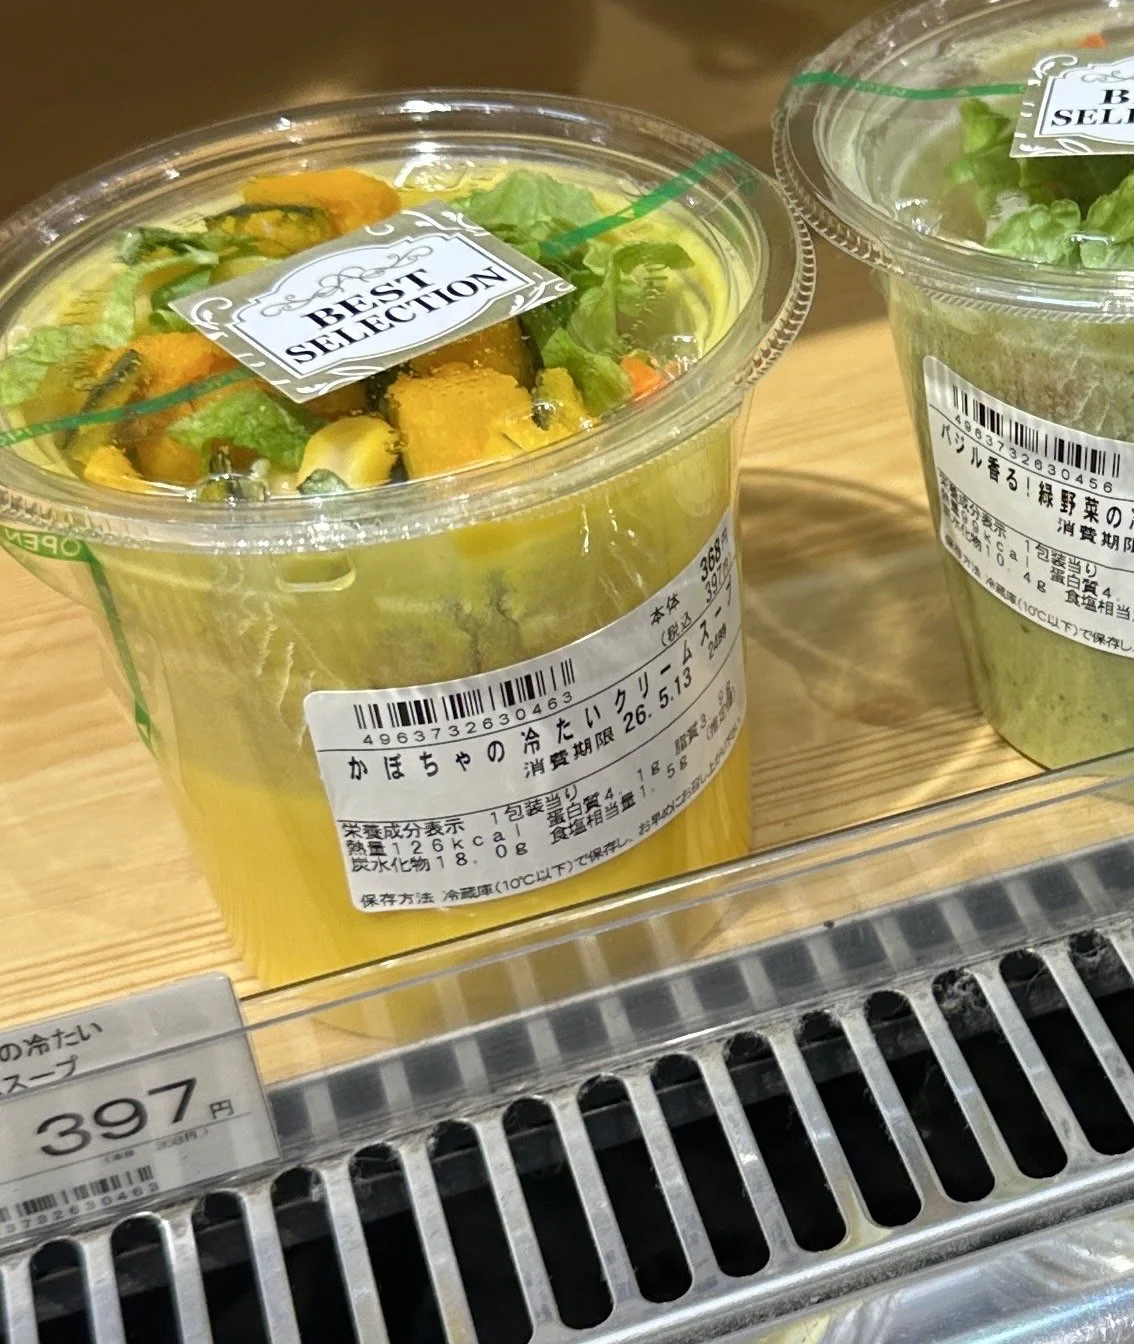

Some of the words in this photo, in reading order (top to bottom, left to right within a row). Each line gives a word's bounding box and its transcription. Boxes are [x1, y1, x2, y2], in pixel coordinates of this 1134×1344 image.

[285, 265, 508, 365] SELECTION
[301, 267, 432, 332] BEST
[954, 414, 1113, 494] 4963732630456
[650, 592, 680, 625] 本体
[363, 691, 573, 746] 4963732630463
[524, 730, 615, 779] 消費期限
[342, 818, 464, 840] 栄養成分表示
[360, 892, 434, 908] 保存方法
[0, 1022, 103, 1062] の冷たい
[0, 1055, 78, 1094] スープ
